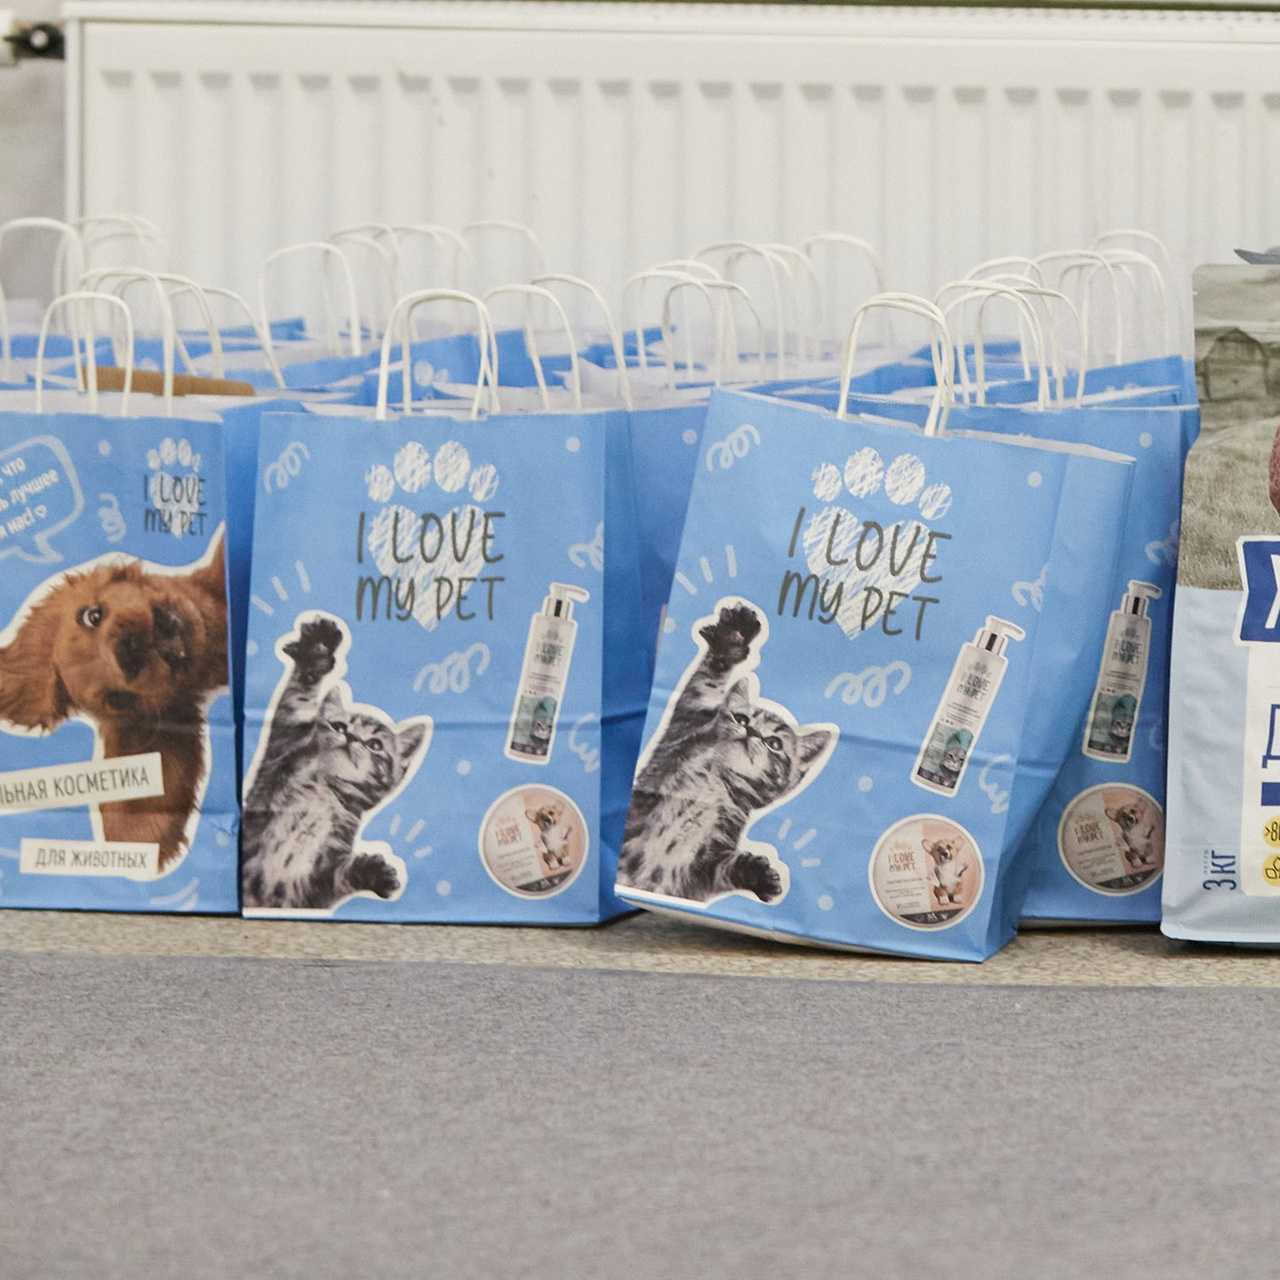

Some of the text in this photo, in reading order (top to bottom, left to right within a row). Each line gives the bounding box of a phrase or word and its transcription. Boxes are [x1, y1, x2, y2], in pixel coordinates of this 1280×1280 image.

[10, 469, 59, 505] лучшее
[159, 474, 207, 506] LOVE
[181, 510, 208, 536] PET
[356, 508, 506, 564] I LOVE
[787, 506, 953, 584] I LOVE
[434, 575, 506, 621] PET
[860, 586, 940, 642] PET
[53, 765, 150, 799] КОСМЕТИКА
[35, 847, 148, 870] ДЛЯ ЖИВОТНЫХ
[1202, 849, 1237, 891] 3 КГ
